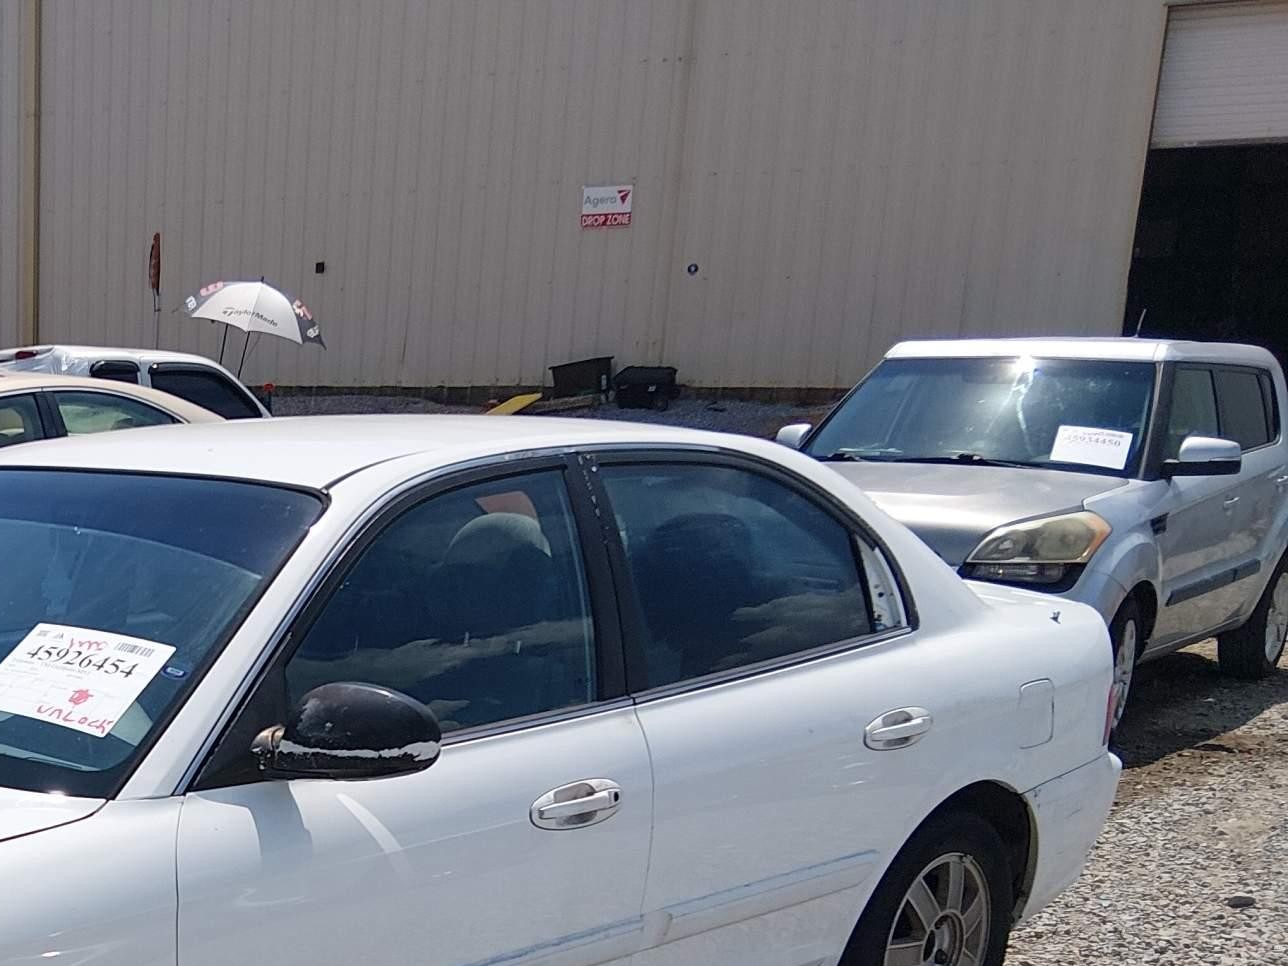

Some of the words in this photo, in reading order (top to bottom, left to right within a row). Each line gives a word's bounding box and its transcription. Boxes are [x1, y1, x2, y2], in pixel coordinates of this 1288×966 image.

[584, 196, 617, 208] Agero
[582, 215, 605, 226] DROP
[607, 214, 630, 225] ZONE
[222, 306, 279, 328] TaylorMade
[27, 645, 140, 679] 45926454
